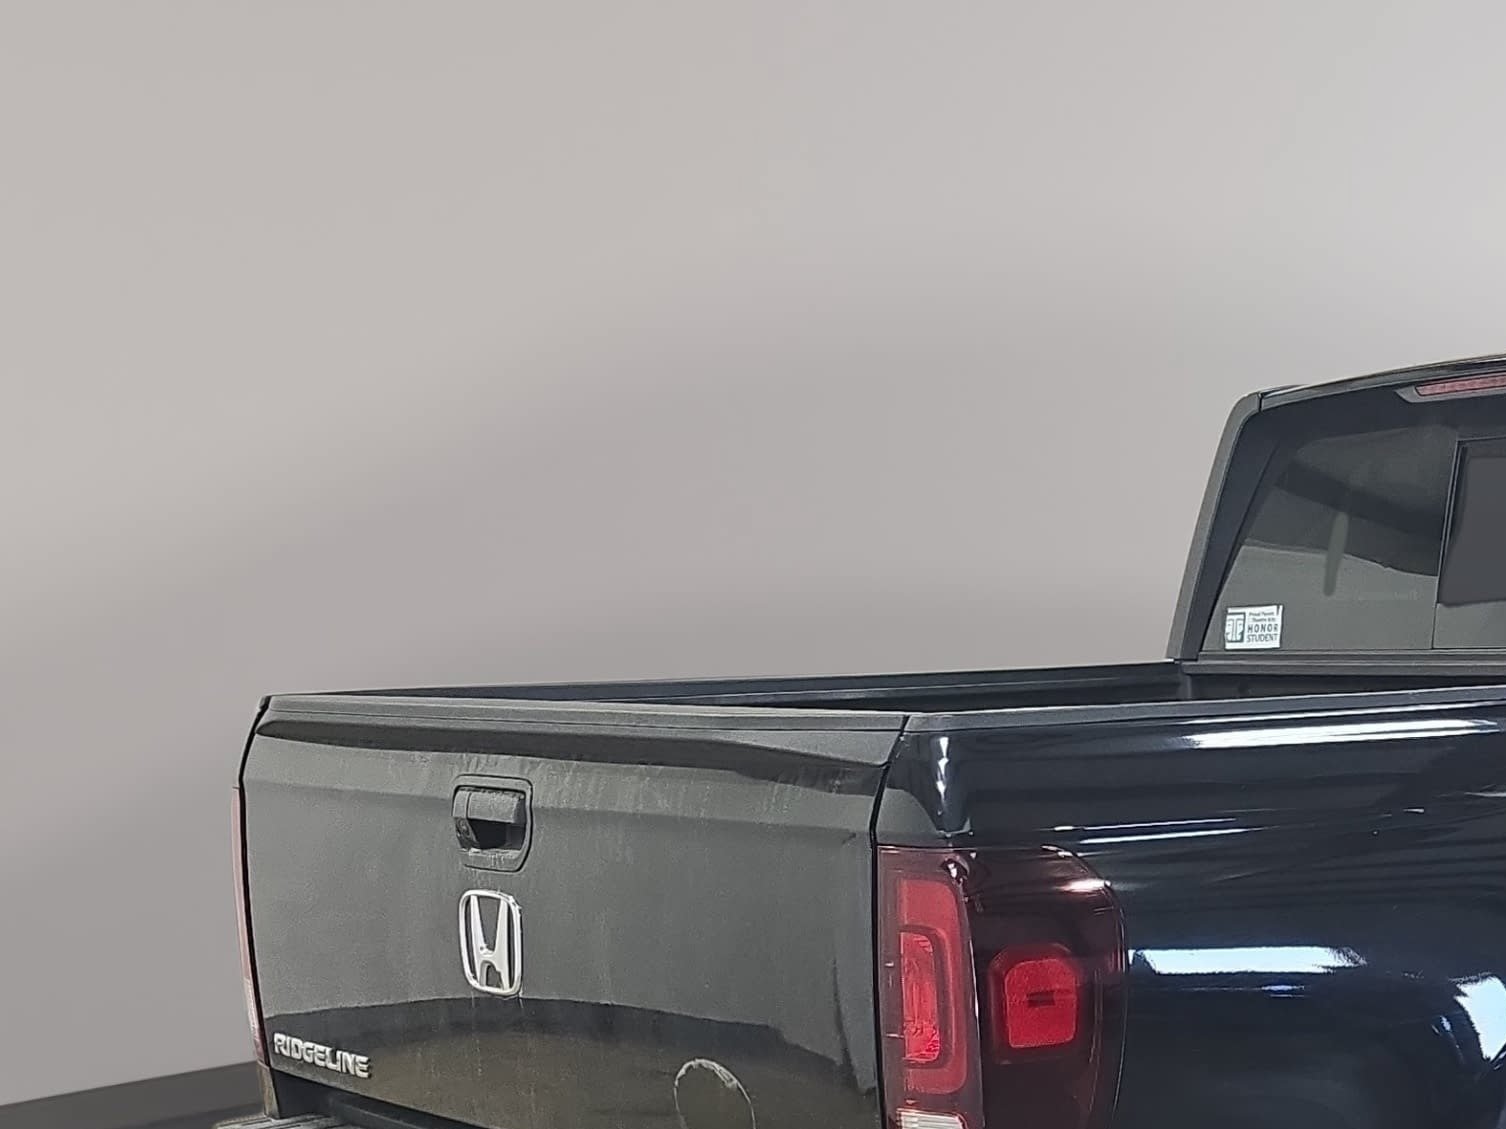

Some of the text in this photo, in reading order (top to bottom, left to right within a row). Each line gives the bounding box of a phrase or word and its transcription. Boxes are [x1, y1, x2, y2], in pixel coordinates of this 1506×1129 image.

[1247, 623, 1278, 633] HONOR
[1247, 633, 1278, 642] STUDENT
[273, 1032, 370, 1078] RIDGELINE
